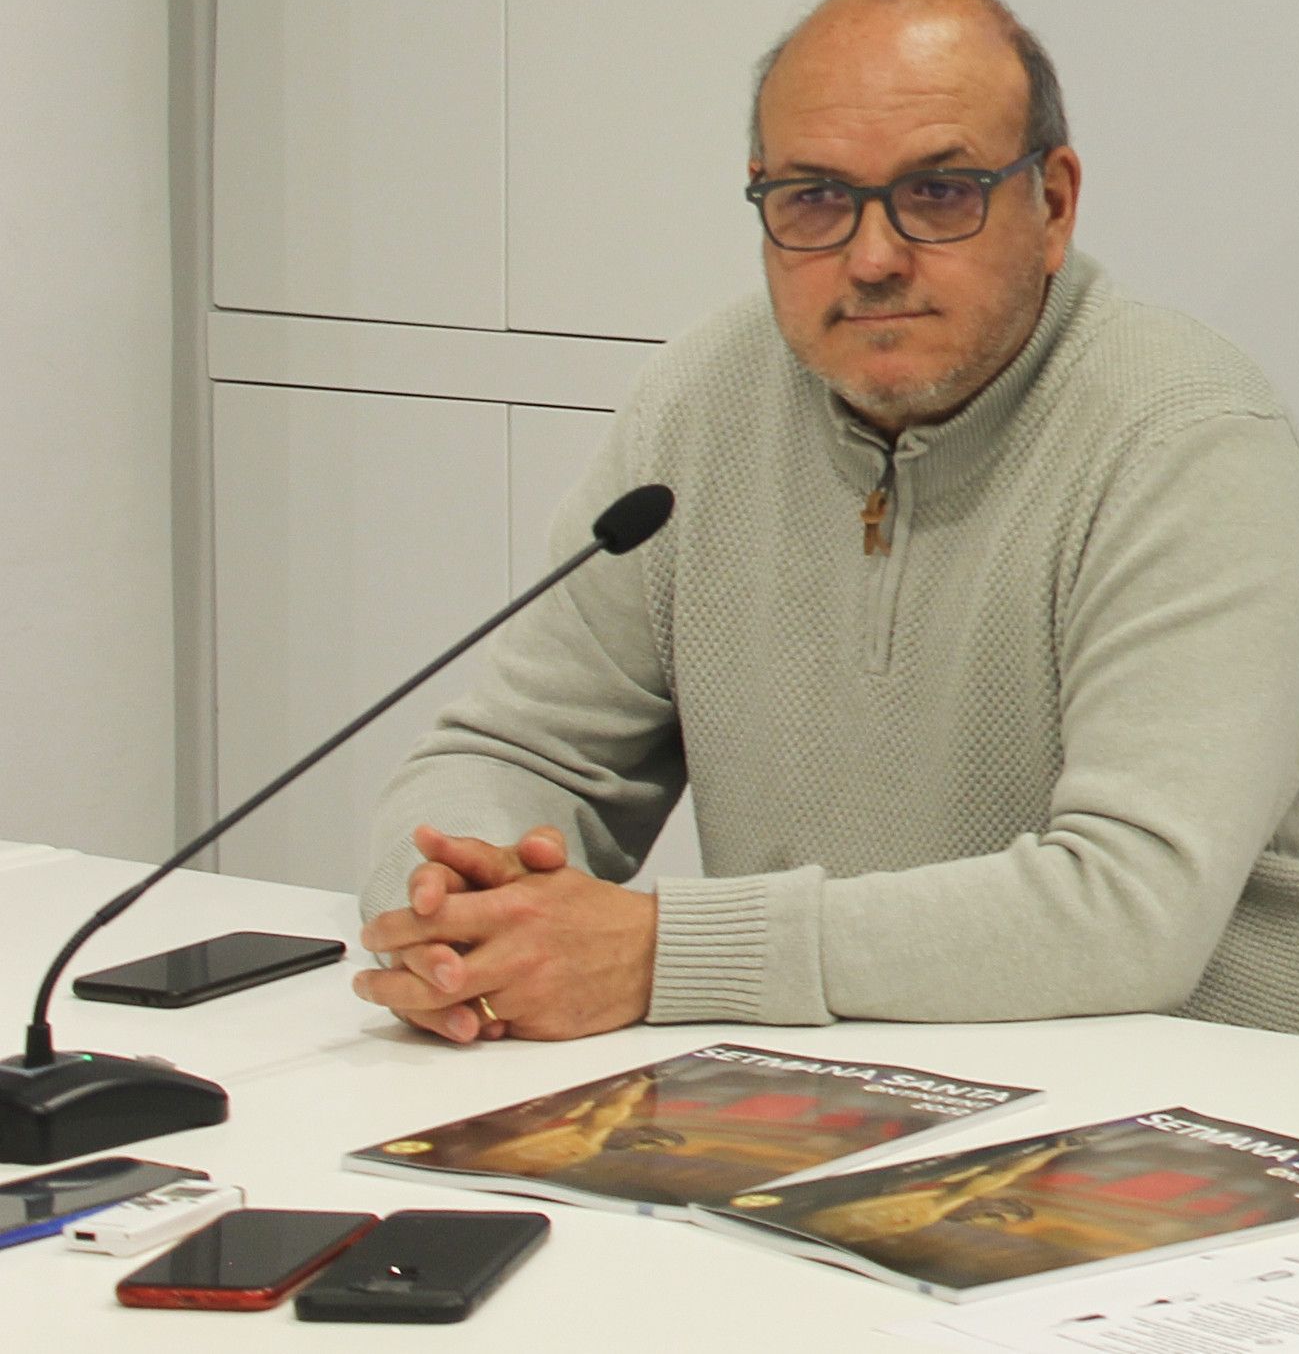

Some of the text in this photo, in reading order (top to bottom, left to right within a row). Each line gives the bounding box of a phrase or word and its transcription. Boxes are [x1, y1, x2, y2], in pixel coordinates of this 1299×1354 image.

[693, 1048, 1010, 1103] SETMANA SANTA
[1136, 1113, 1298, 1162] SETMANA
